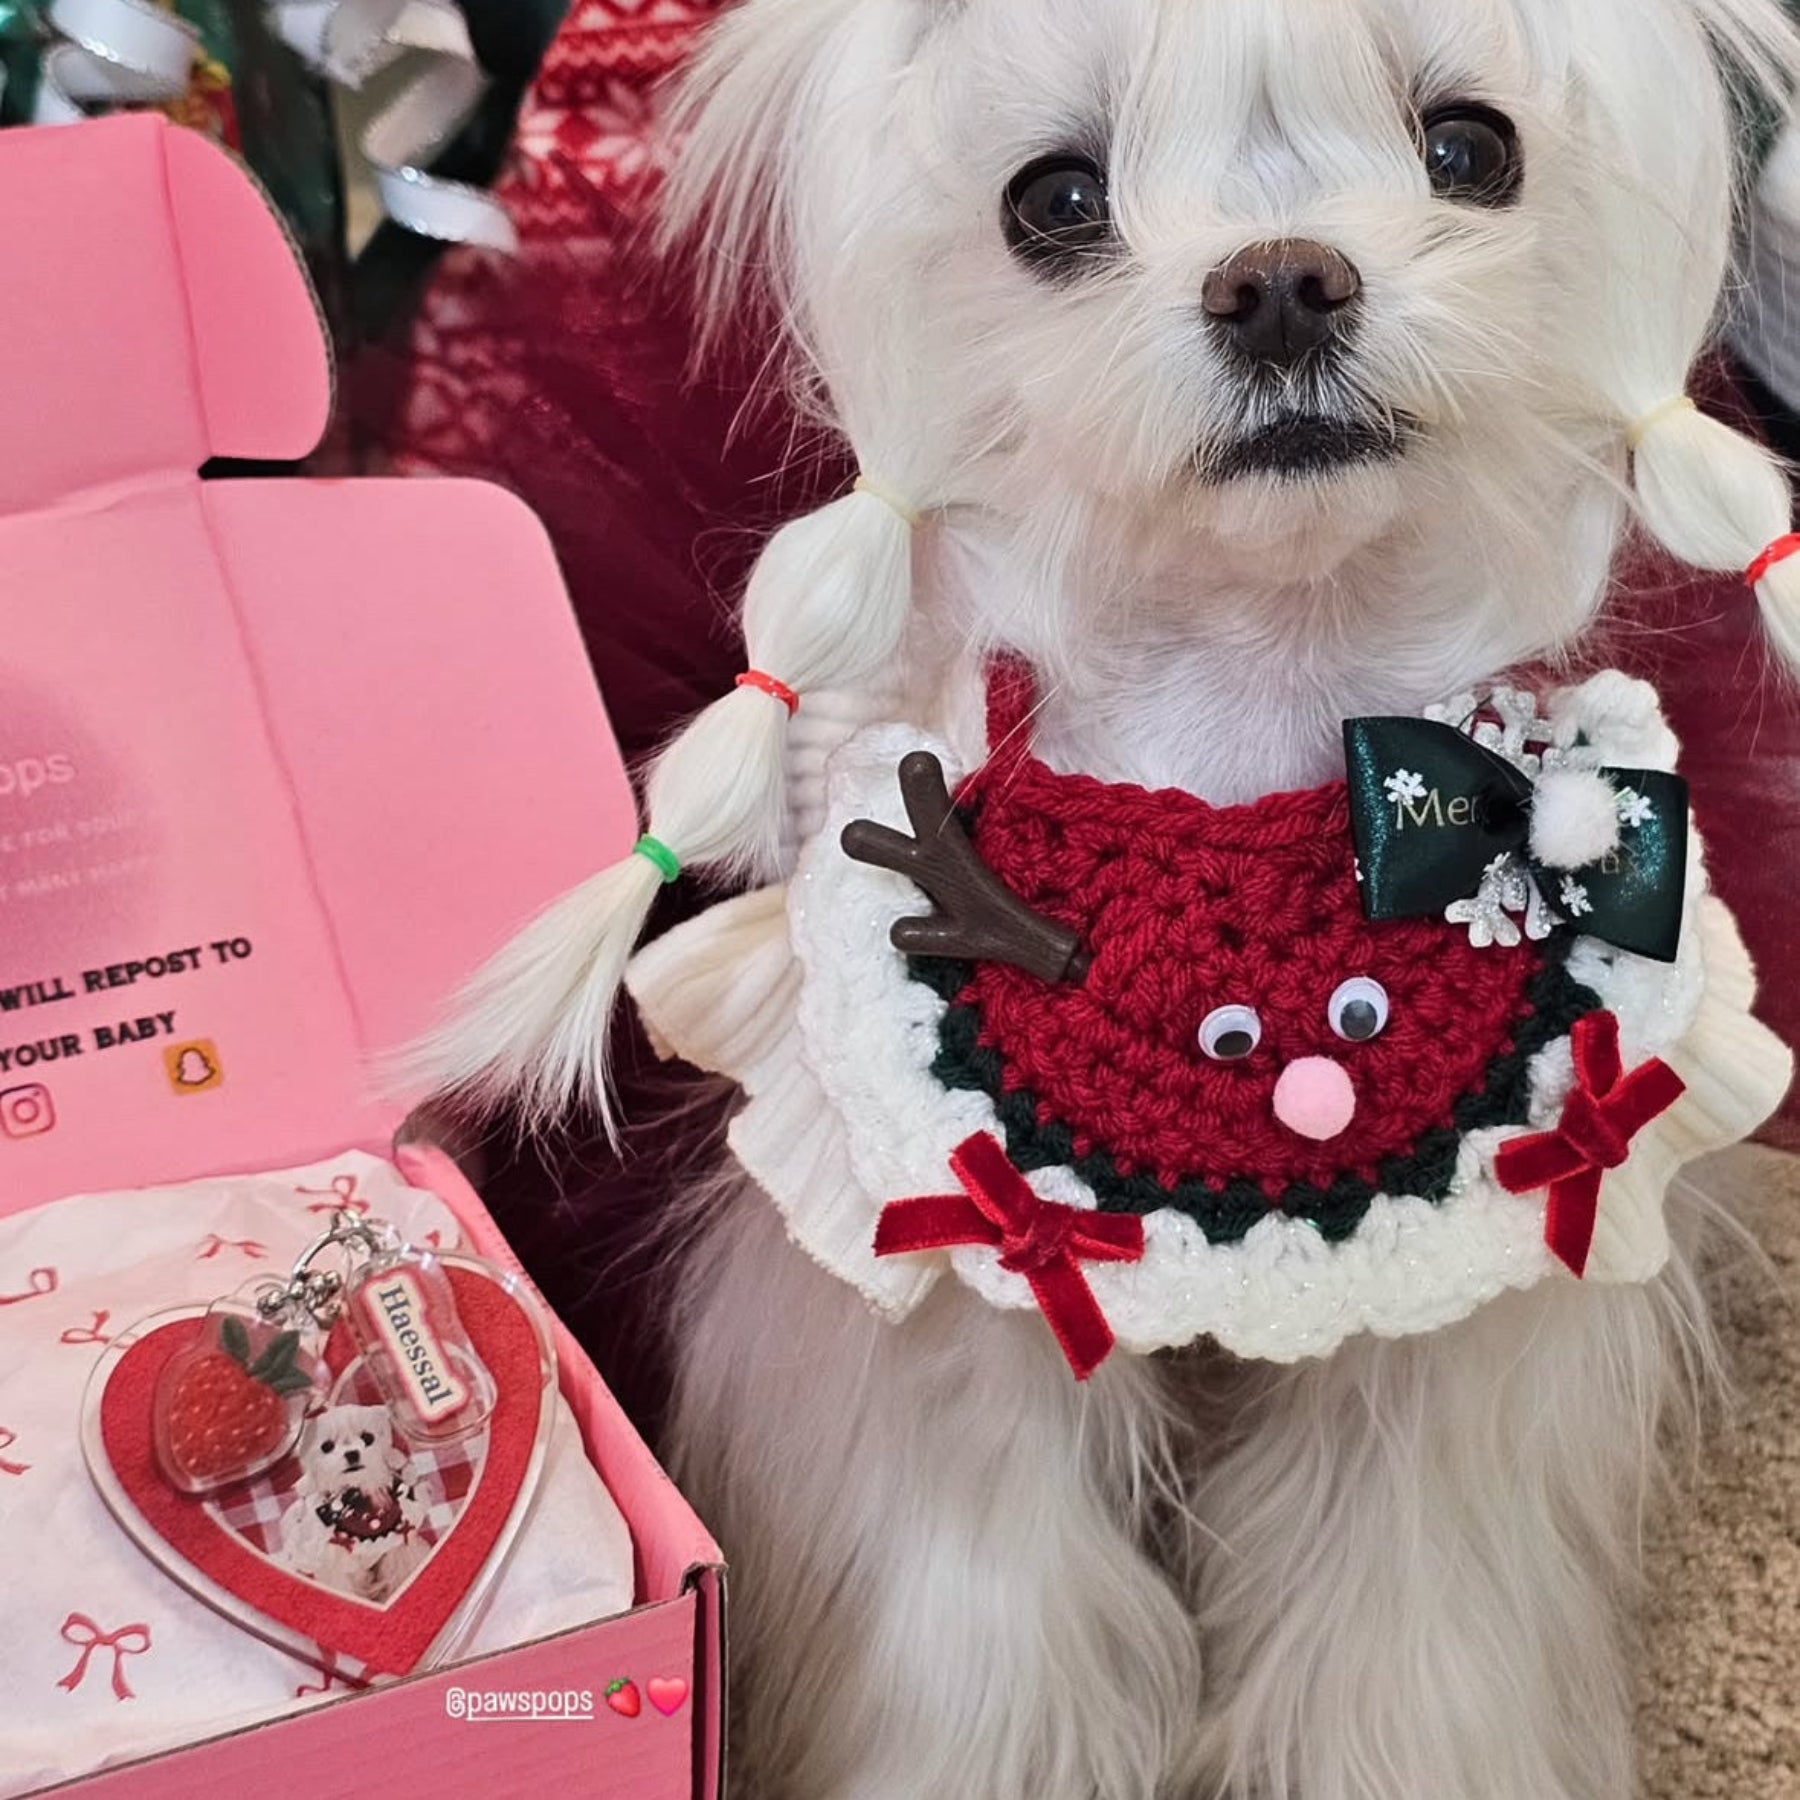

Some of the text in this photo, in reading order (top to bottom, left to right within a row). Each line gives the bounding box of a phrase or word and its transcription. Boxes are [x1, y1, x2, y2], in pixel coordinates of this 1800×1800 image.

[0, 937, 252, 1012] WILL REPOST TO
[0, 1011, 176, 1072] YOUR BABY
[378, 1284, 453, 1406] Haessal
